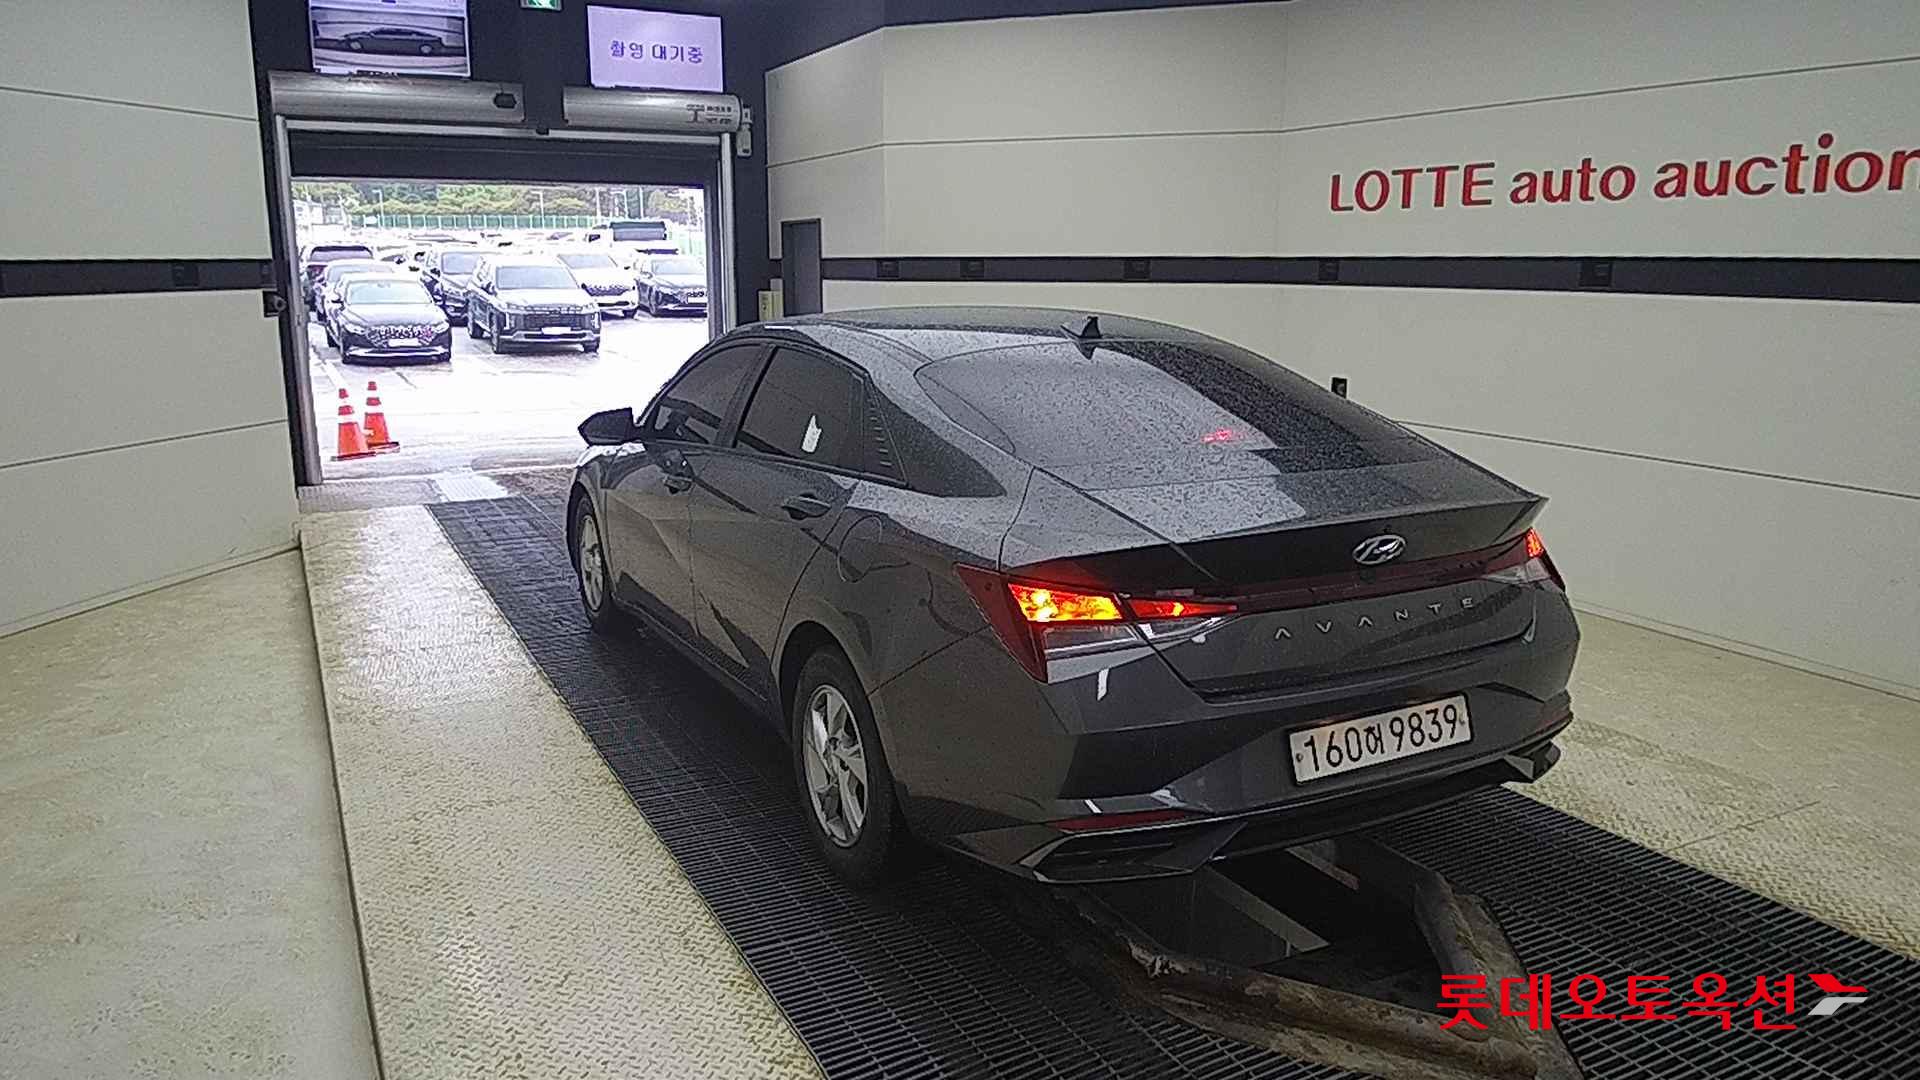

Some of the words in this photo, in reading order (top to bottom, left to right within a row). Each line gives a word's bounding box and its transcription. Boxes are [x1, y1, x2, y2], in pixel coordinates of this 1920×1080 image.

[652, 44, 703, 64] 대기중
[1330, 161, 1496, 212] LOTTE
[1509, 157, 1637, 205] auto
[1275, 597, 1474, 639] AVANTE
